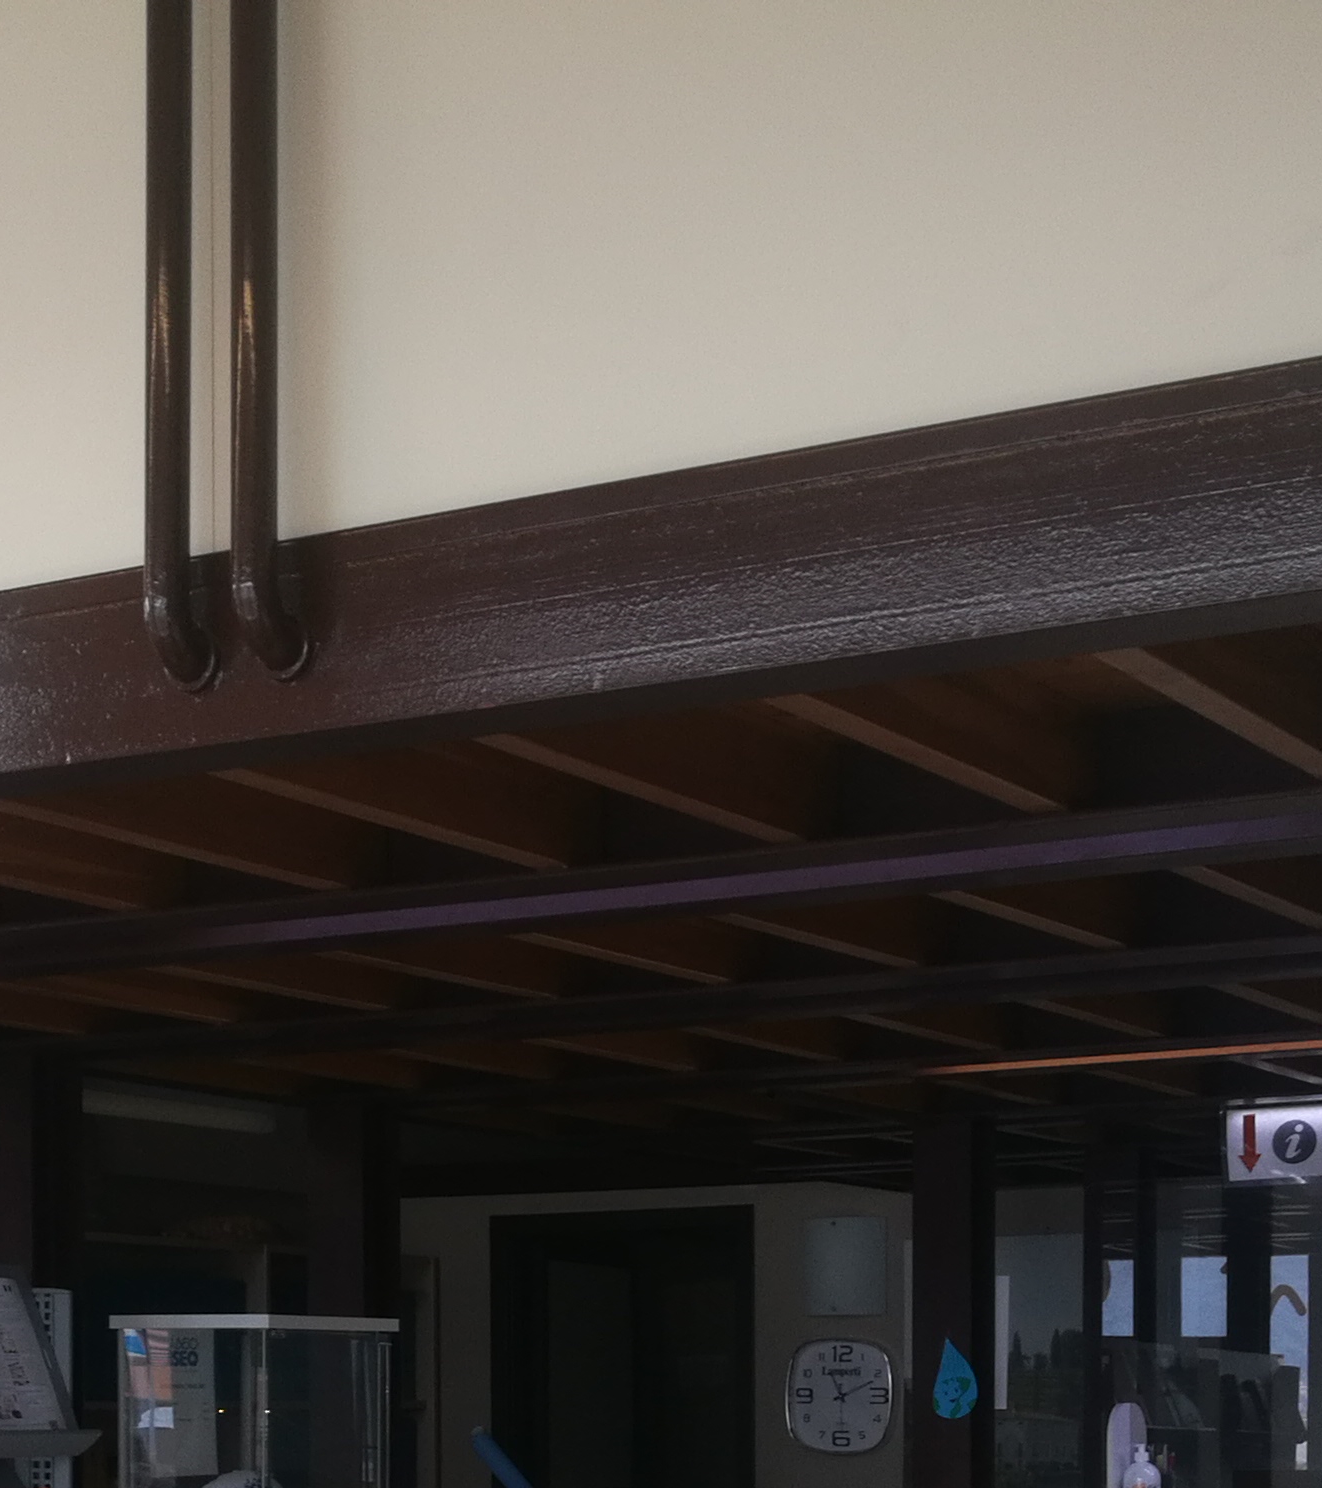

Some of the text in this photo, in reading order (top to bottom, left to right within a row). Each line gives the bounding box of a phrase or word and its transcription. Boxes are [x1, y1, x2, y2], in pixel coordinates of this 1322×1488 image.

[832, 1345, 853, 1363] 12
[874, 1369, 882, 1378] 2
[796, 1387, 813, 1404] 9
[870, 1387, 889, 1404] 3
[832, 1430, 850, 1447] 6
